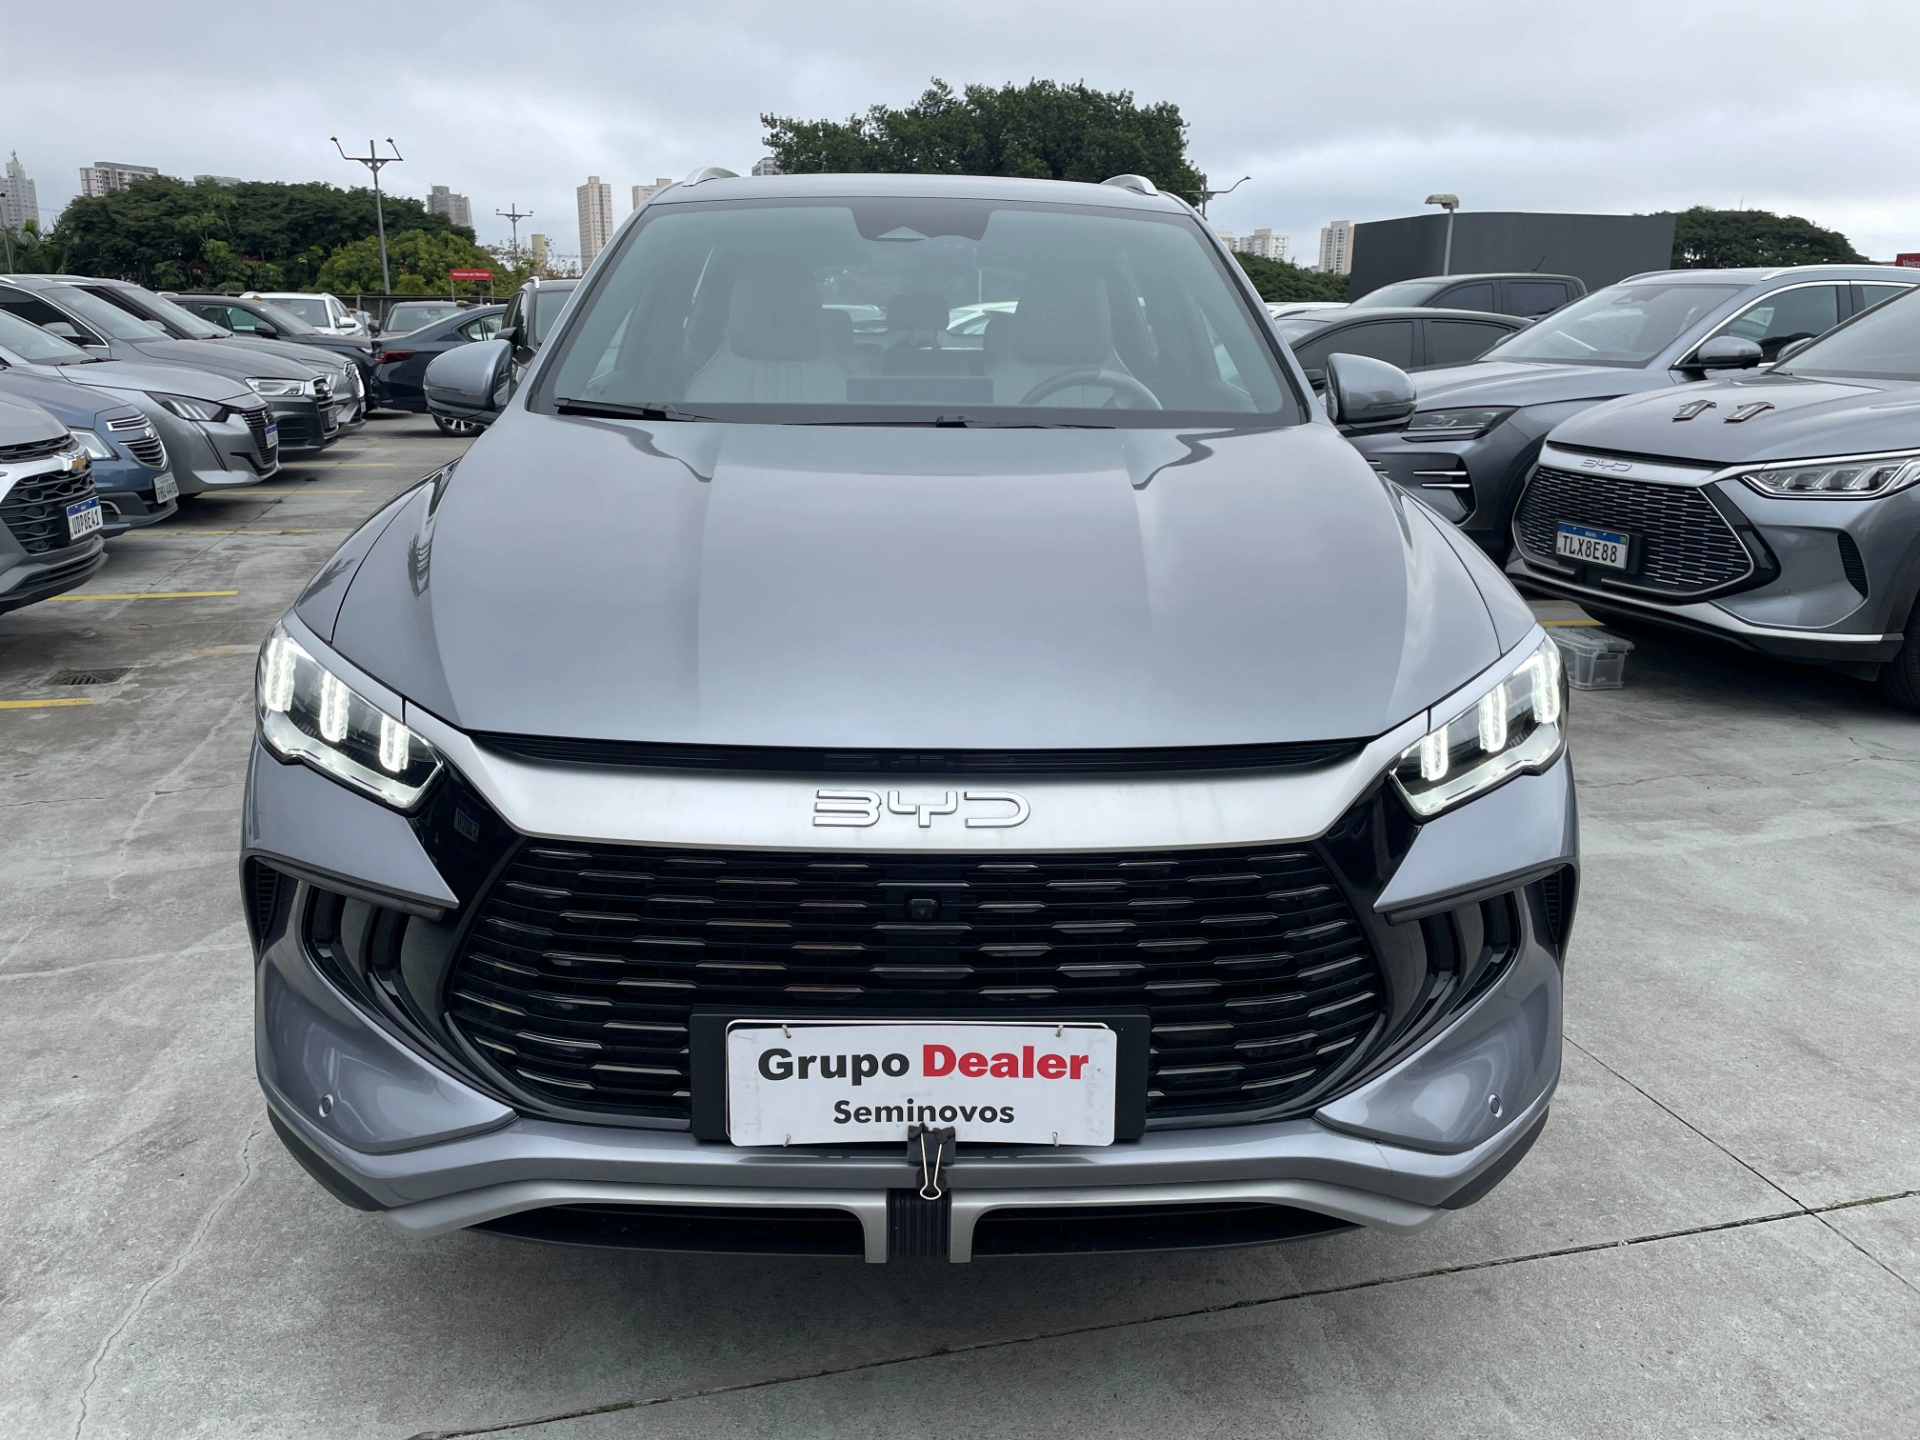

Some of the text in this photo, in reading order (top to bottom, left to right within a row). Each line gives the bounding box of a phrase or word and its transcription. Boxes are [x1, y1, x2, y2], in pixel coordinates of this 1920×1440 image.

[1581, 459, 1632, 472] BYD
[1563, 535, 1618, 563] TLX8E88
[813, 789, 1031, 828] BYD
[758, 1044, 1089, 1086] Grupo Dealer
[833, 1098, 1015, 1124] Seminovos
